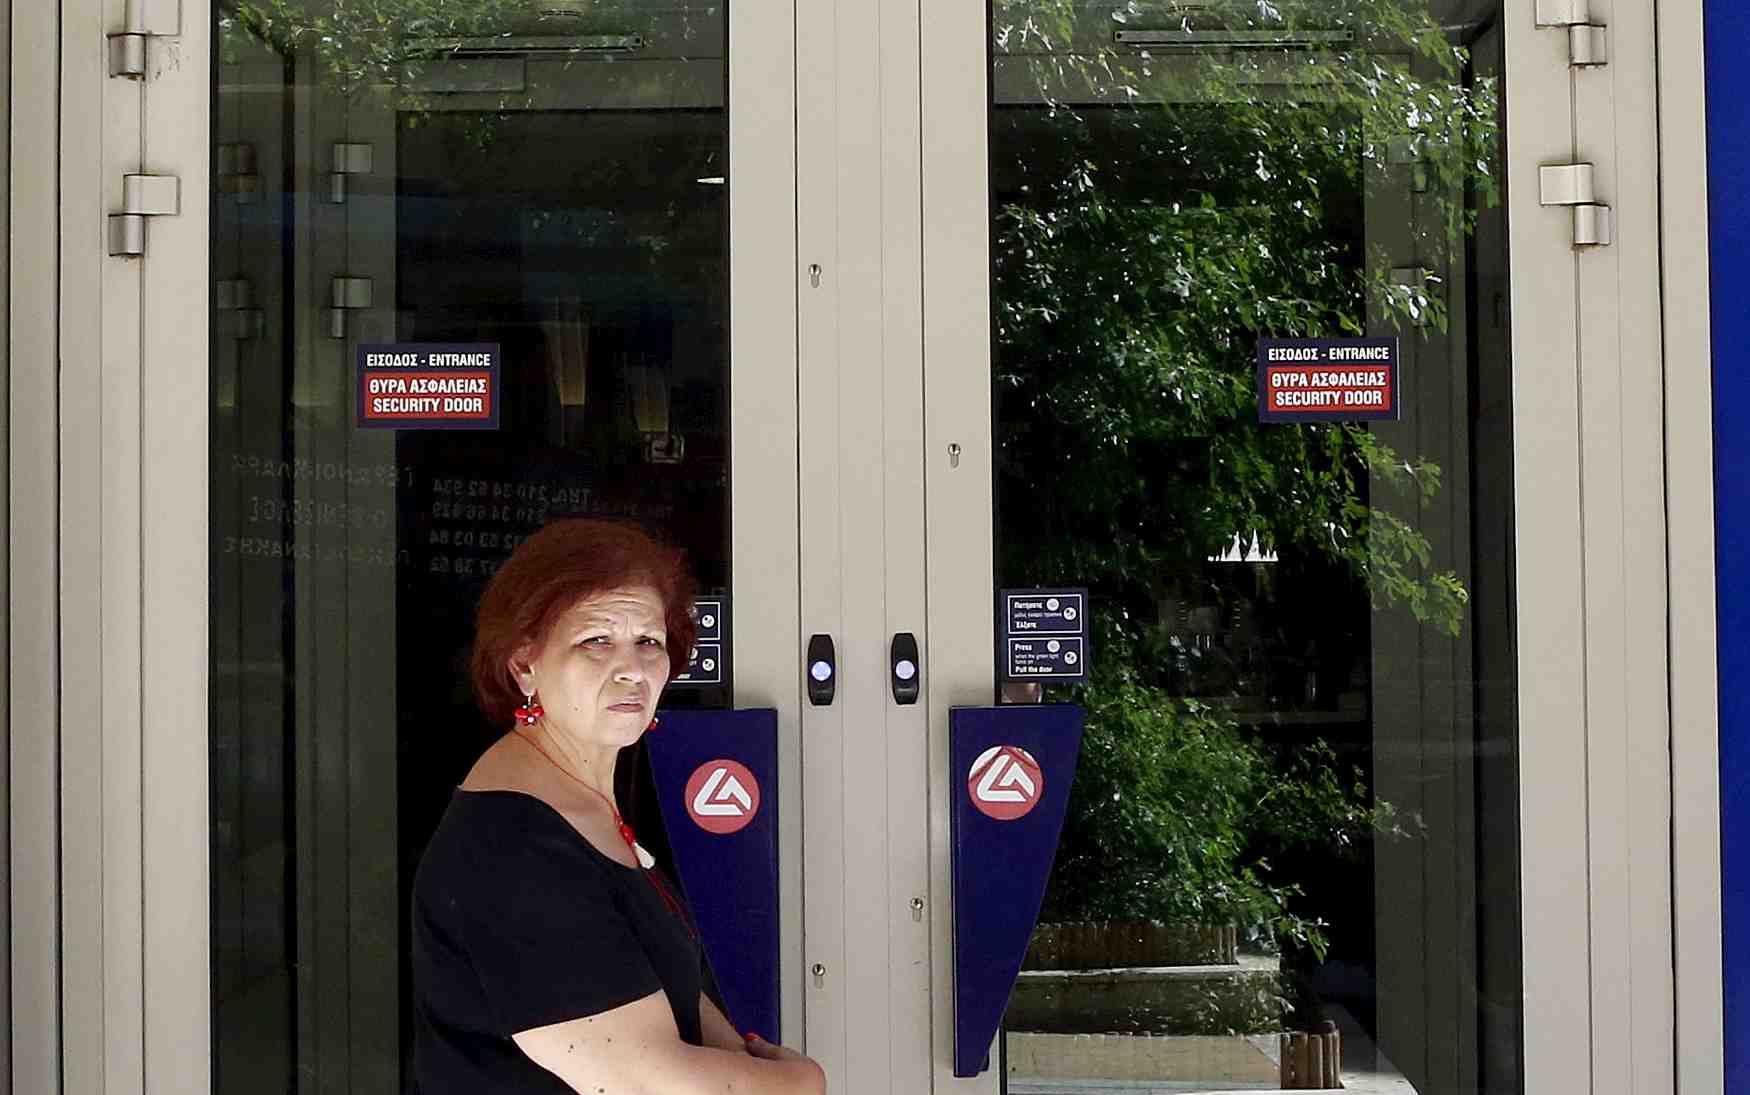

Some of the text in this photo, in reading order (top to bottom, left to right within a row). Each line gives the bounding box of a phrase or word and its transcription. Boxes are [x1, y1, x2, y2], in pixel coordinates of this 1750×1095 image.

[366, 354, 418, 367] ΕΙΣΟΔΟΣ
[429, 353, 491, 367] ENTRANCE
[1268, 348, 1318, 361] ΕΙΣΟΔΟΣ
[1329, 347, 1389, 360] ENTRANCE
[369, 379, 487, 393] ΘΥΡΑ ΑΣΦΑΛΕΙΑΣ
[1272, 372, 1386, 387] ΘΥΡΑ ΑΣΦΑΛΕΙΑΣ
[1276, 390, 1382, 406] SECURITY DOOR
[373, 398, 482, 413] SECURITY DOOR
